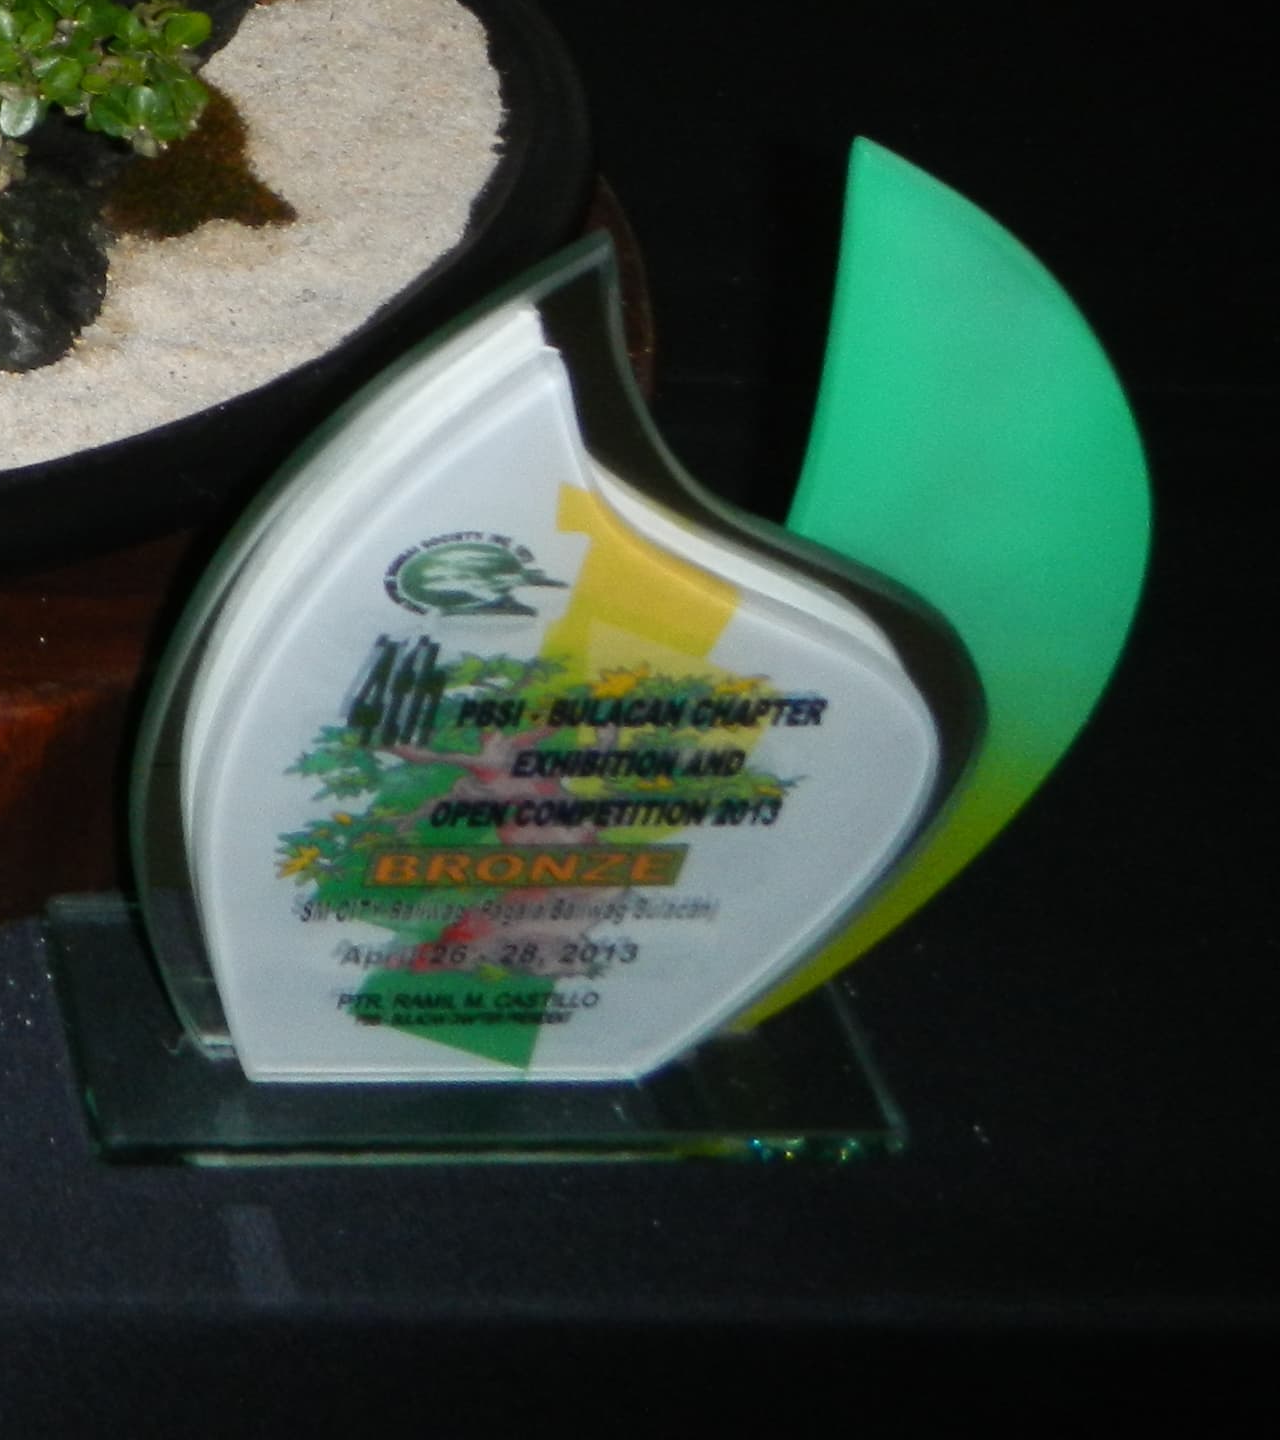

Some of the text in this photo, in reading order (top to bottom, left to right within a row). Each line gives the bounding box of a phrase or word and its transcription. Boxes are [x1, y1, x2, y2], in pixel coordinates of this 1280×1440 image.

[457, 698, 523, 728] PBSI
[547, 698, 688, 728] BULACAN
[691, 697, 828, 728] CHAPTER
[512, 749, 746, 778] EXHIBITION AND
[429, 799, 784, 827] OPEN COMPETITION 2013
[373, 853, 678, 885] BRONZE
[428, 944, 468, 965] 26
[557, 943, 641, 964] 2013
[495, 990, 601, 1010] CASTILLO
